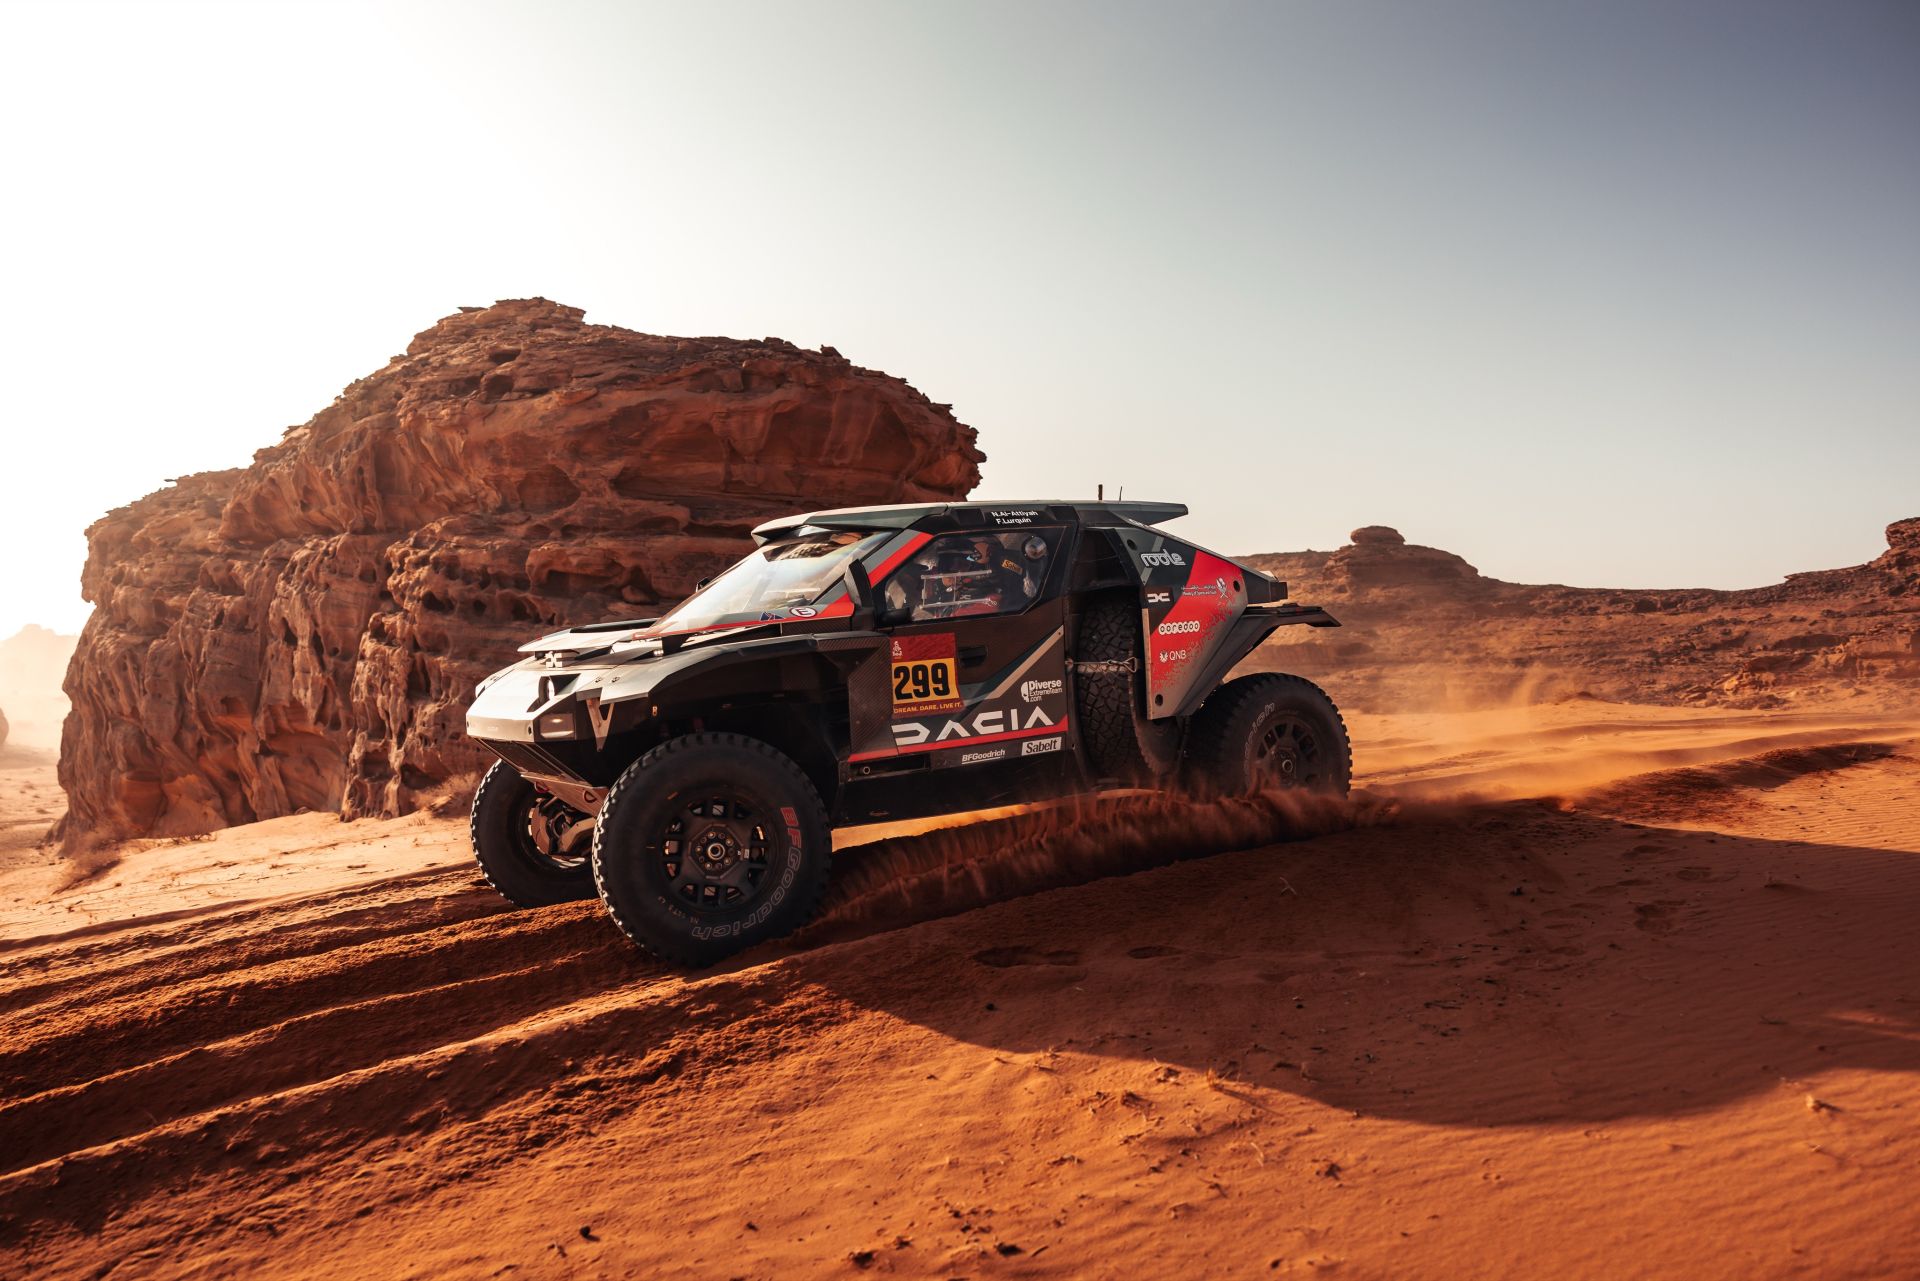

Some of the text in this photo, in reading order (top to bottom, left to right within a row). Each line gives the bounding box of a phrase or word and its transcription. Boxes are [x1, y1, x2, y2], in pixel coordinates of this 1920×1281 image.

[1159, 622, 1199, 634] ooredoo
[1169, 650, 1187, 660] QNB
[894, 663, 950, 700] 299
[1029, 680, 1062, 691] Diverse
[891, 705, 1054, 746] DACIA
[1026, 739, 1058, 754] Sabelt
[962, 749, 1006, 762] BFGoodrich
[691, 807, 801, 941] BFGoodrich
